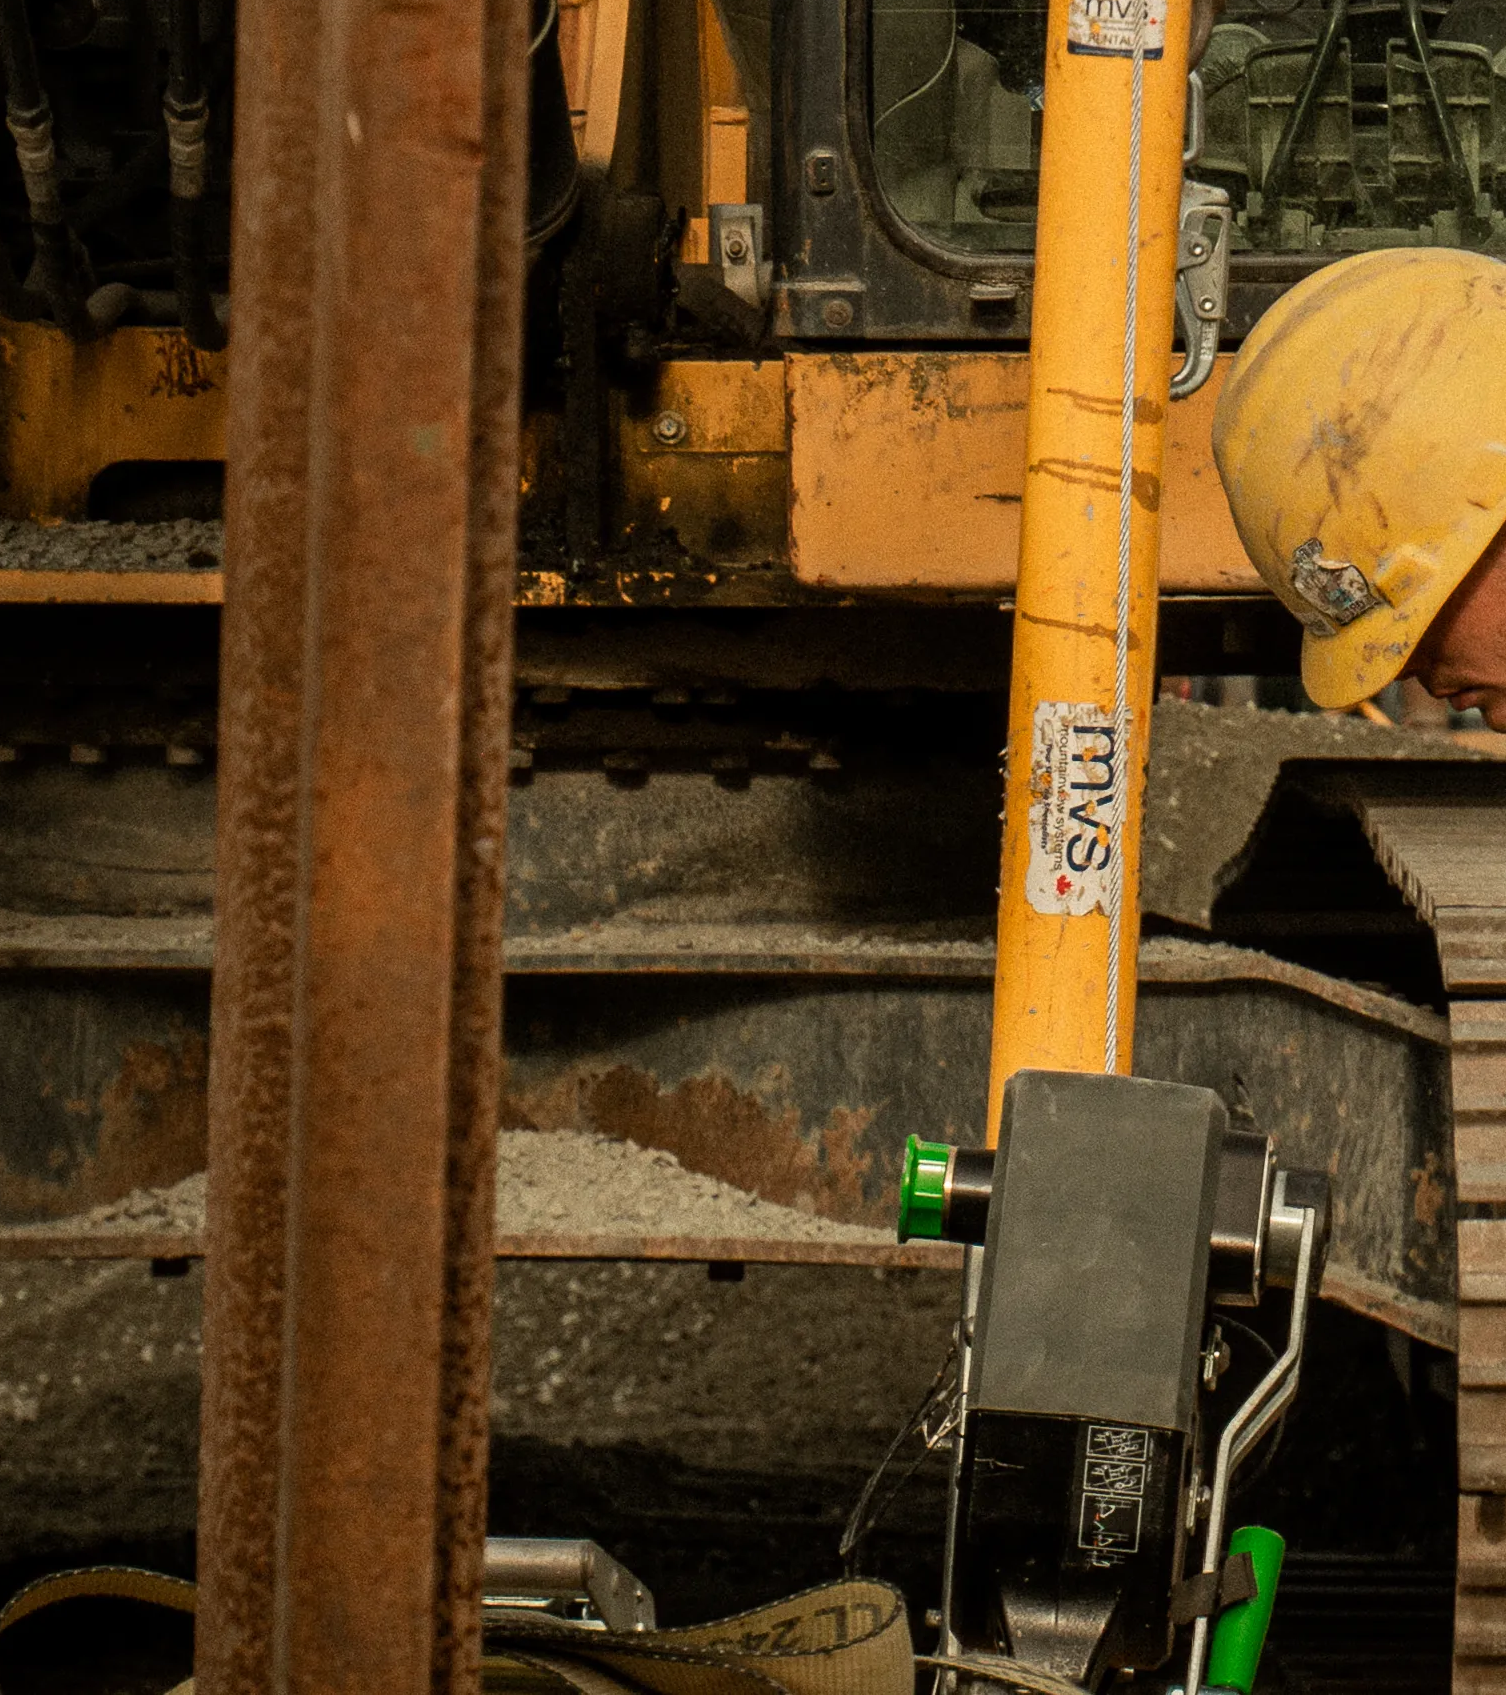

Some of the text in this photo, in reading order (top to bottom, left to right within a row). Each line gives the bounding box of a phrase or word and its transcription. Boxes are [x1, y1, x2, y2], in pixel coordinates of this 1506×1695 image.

[1053, 722, 1070, 872] mountainvew systems
[1067, 725, 1115, 872] mvs
